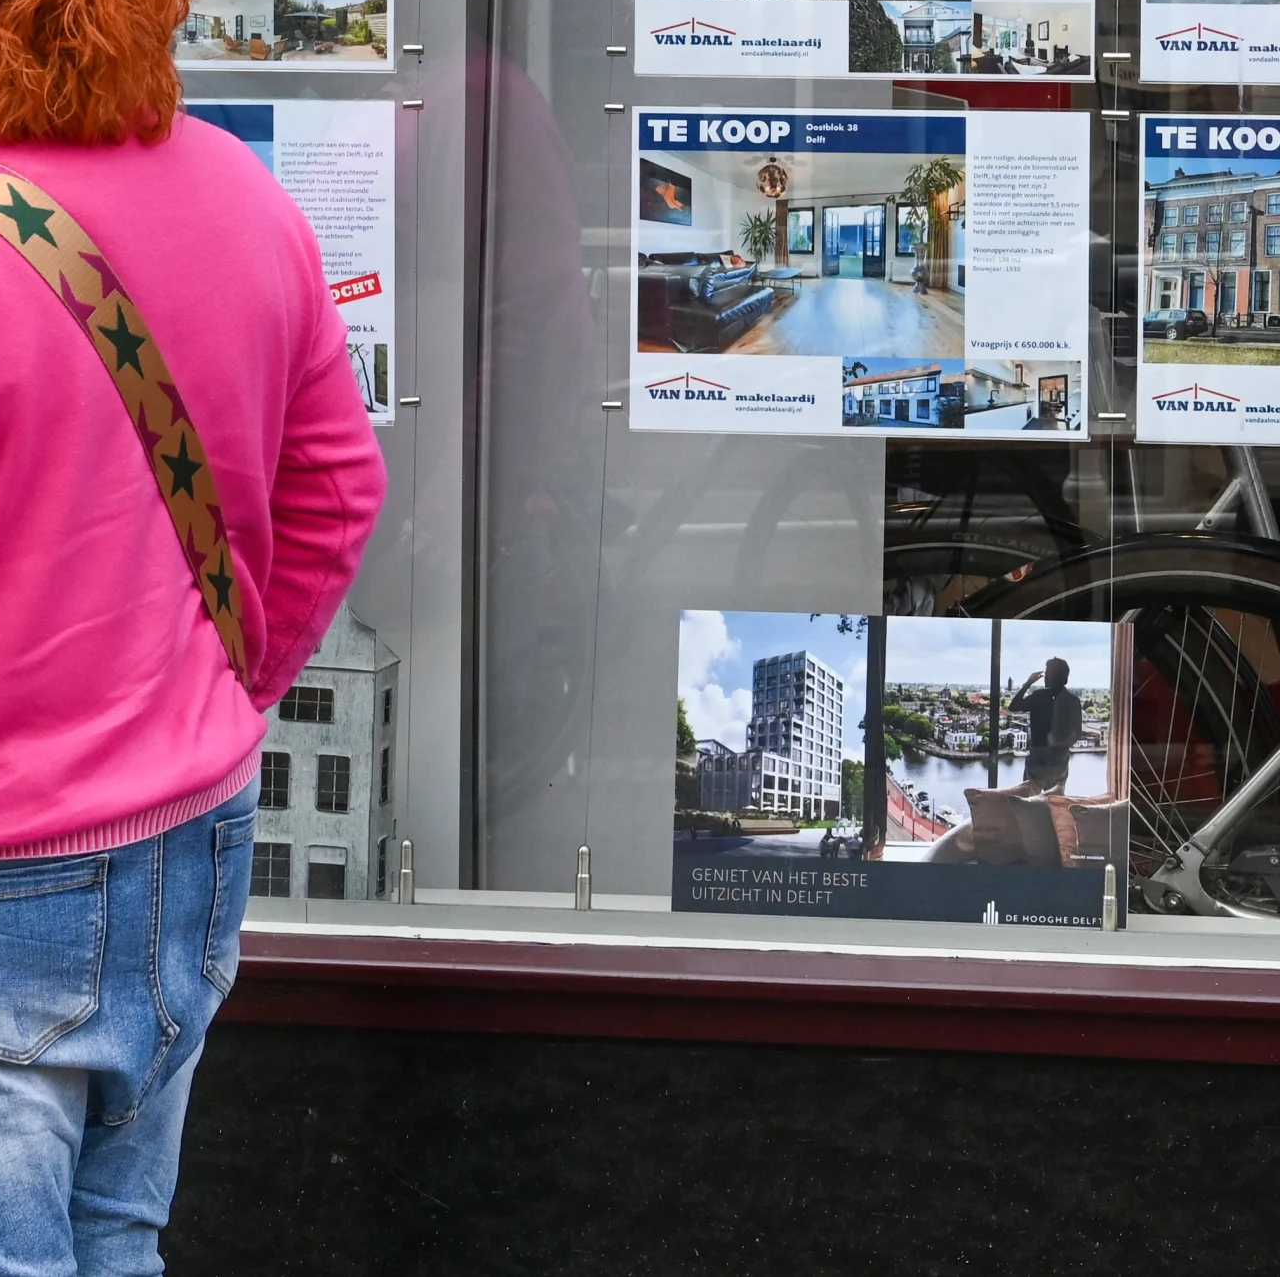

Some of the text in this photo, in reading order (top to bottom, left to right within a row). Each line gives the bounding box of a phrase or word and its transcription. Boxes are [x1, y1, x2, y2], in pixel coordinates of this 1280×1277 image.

[648, 120, 790, 144] TE KOOP
[806, 123, 858, 132] Oostblok 38
[806, 135, 826, 144] Delft
[692, 868, 868, 887] GENIET VAN HET BESTE
[692, 887, 833, 904] UITZICHT IN DELFT
[1022, 915, 1068, 923] HOOGHE
